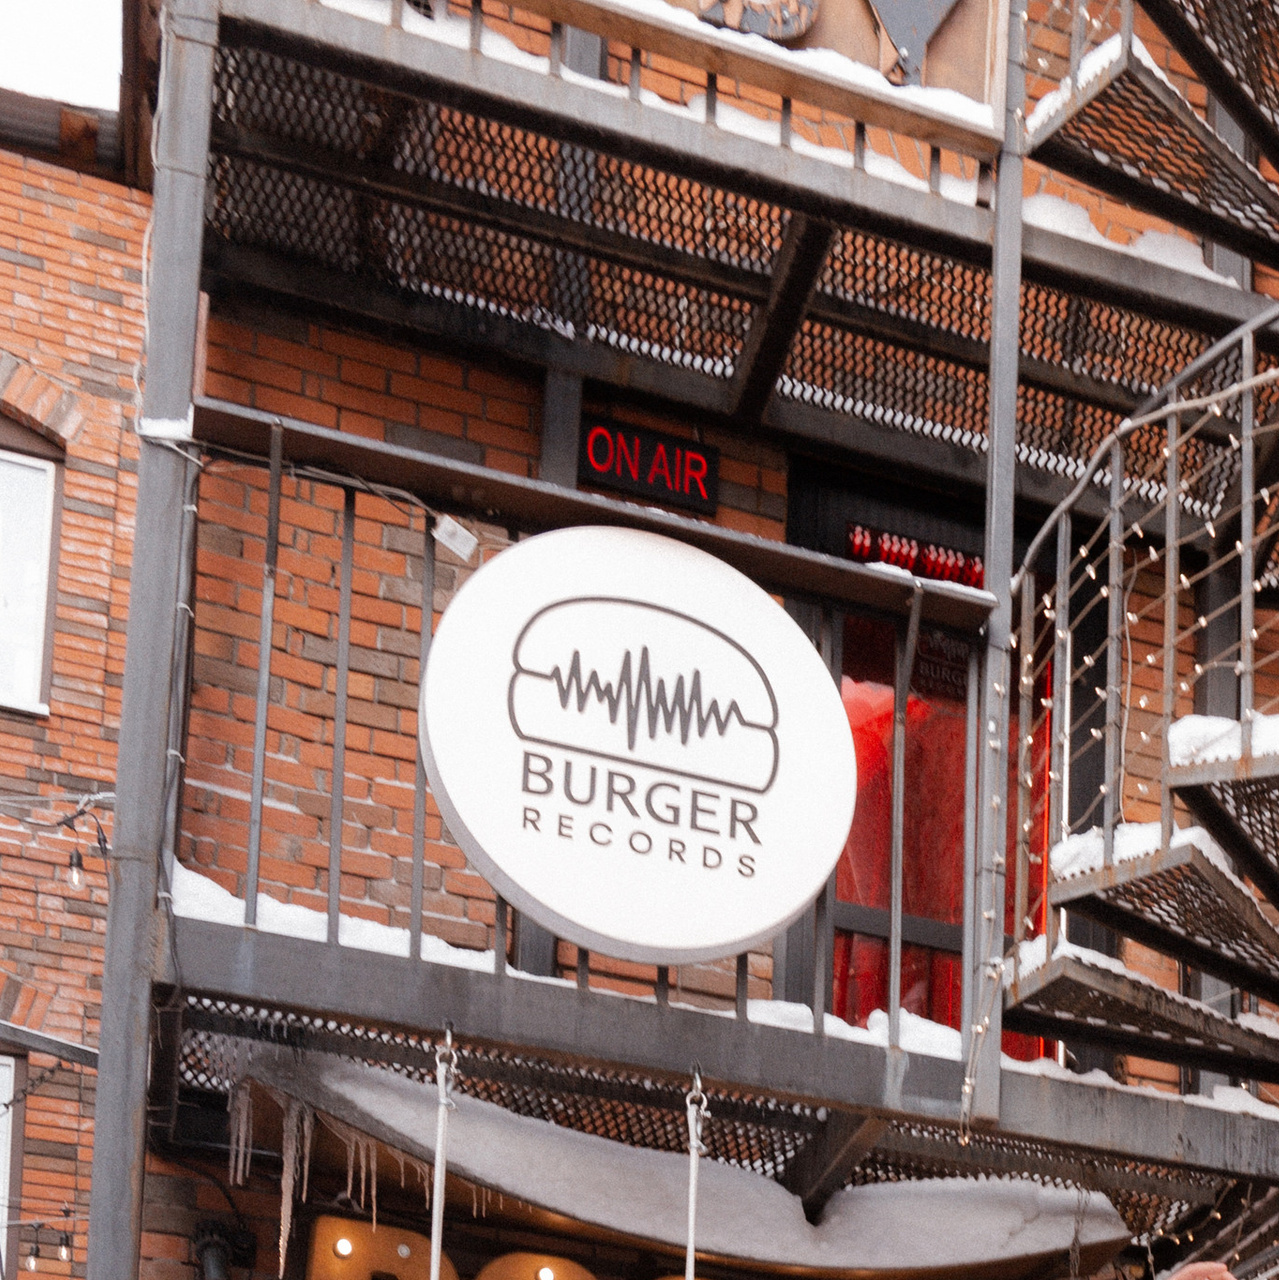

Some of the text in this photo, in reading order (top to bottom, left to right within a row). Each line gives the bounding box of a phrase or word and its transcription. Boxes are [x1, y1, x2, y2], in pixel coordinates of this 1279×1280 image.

[586, 425, 709, 500] ON AIR
[521, 751, 762, 846] BURGER
[521, 806, 757, 878] RECORDS
